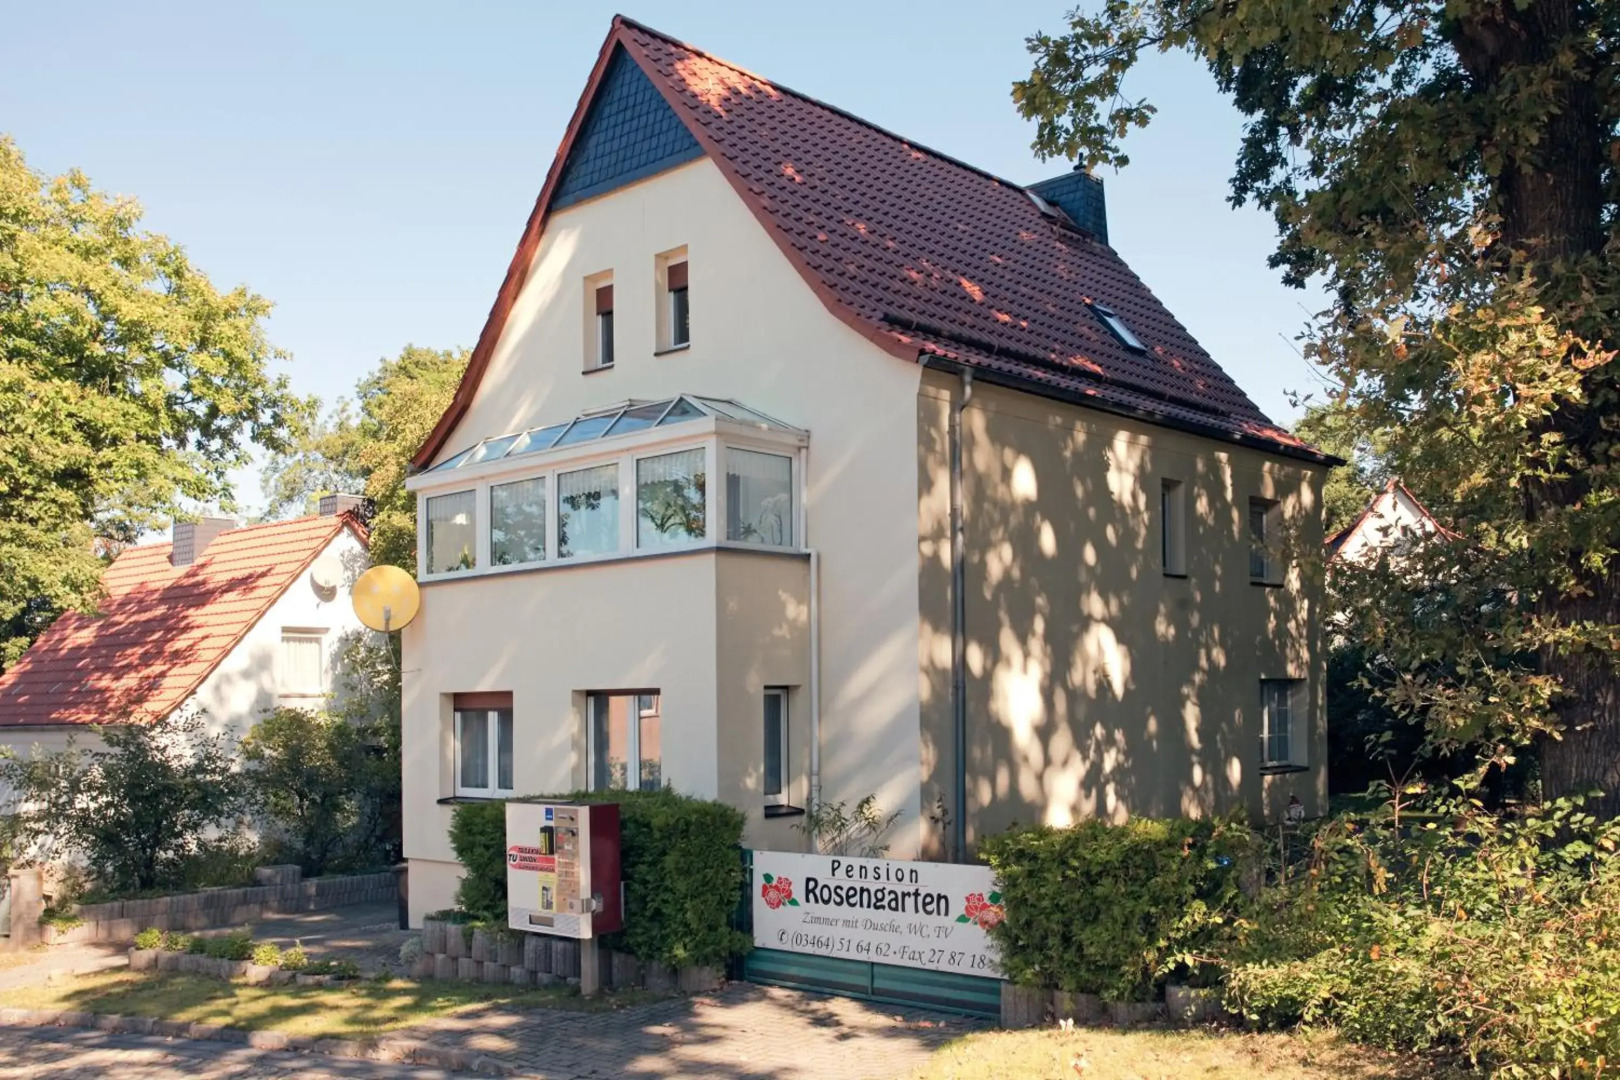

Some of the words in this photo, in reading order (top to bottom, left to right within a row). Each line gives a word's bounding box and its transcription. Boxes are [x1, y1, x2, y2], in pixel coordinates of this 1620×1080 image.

[508, 854, 518, 862] TU
[831, 859, 920, 884] Pension
[805, 877, 950, 916] Rosengarten
[802, 912, 840, 927] Zimmer
[842, 915, 859, 928] mit
[861, 917, 903, 935] Dusche,
[907, 922, 930, 939] WC,
[934, 925, 954, 939] TV
[790, 930, 835, 954] (03464)
[837, 937, 852, 952] 51
[855, 939, 871, 955] 64
[875, 942, 890, 957] 62
[898, 945, 927, 965] Fax
[928, 948, 944, 963] 27
[947, 951, 965, 967] 87
[971, 953, 986, 969] 18
